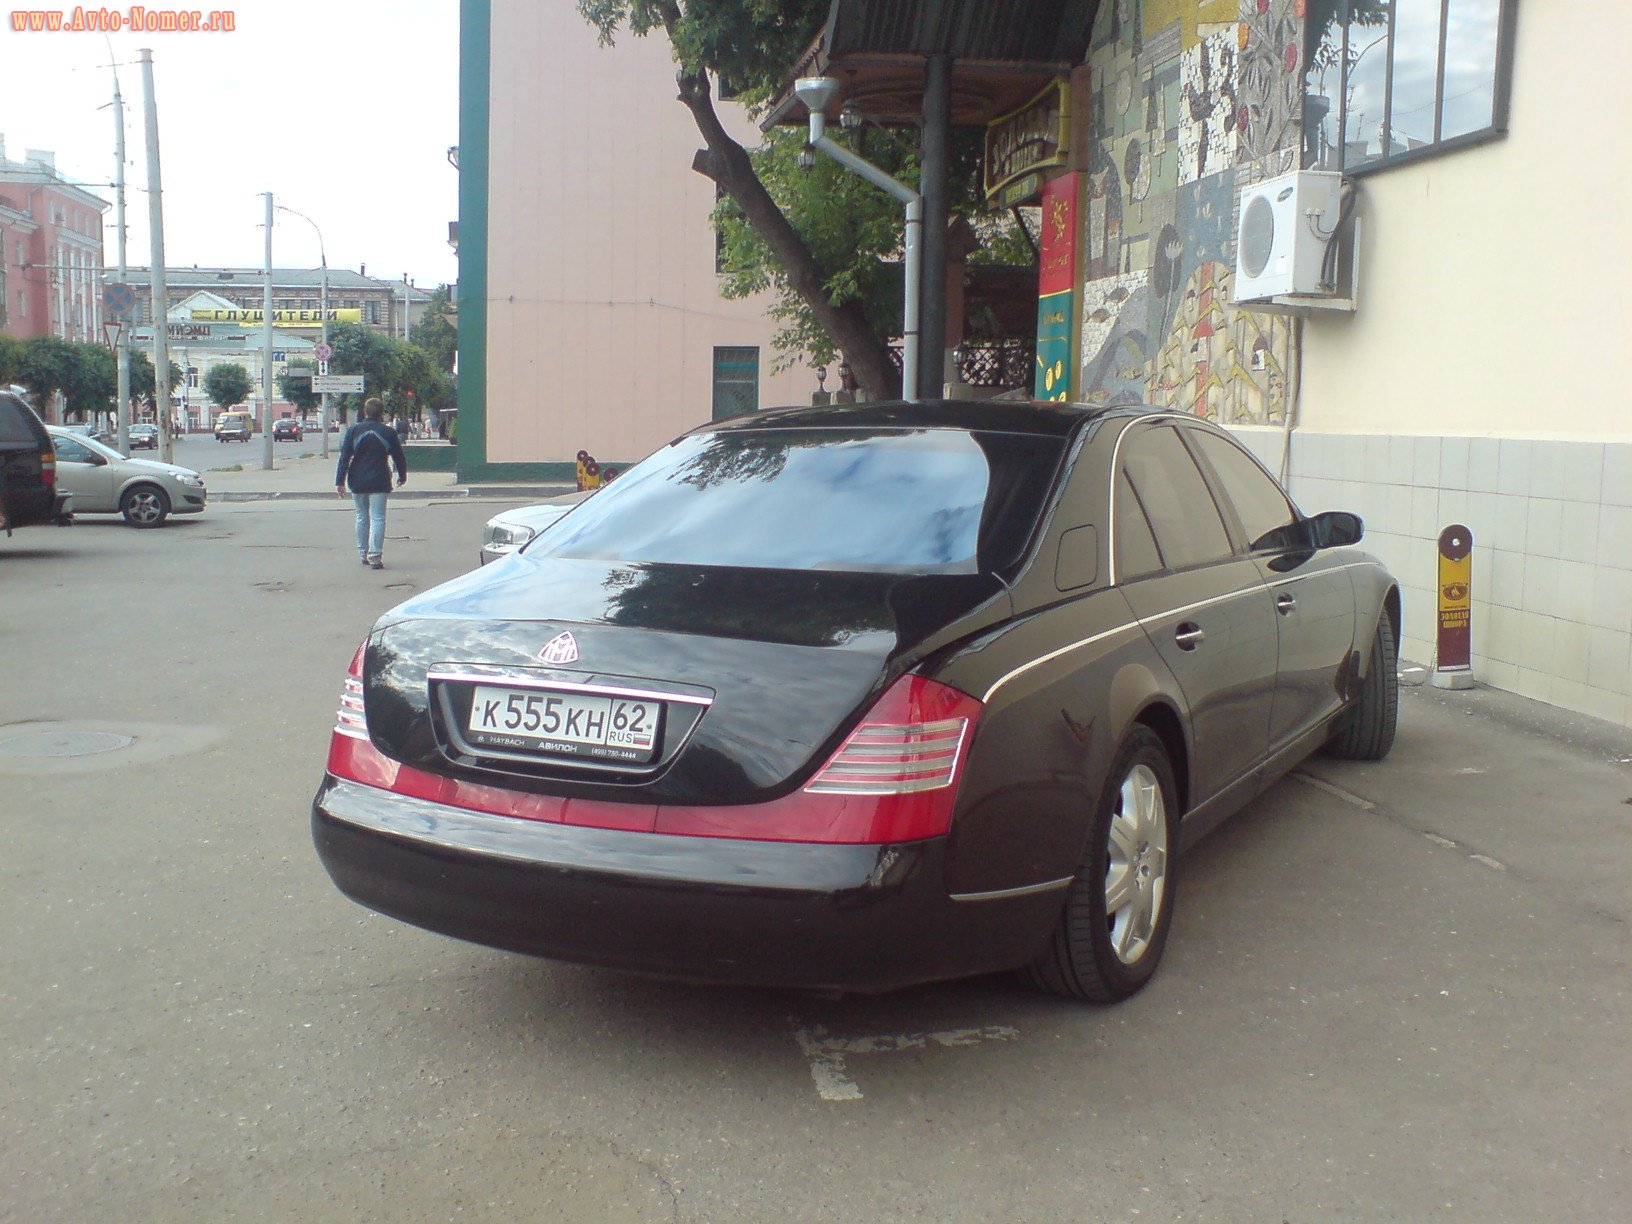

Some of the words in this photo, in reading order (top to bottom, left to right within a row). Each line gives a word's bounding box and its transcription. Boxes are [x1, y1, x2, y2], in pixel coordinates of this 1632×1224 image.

[613, 702, 647, 732] 62
[609, 732, 633, 744] RUS
[538, 741, 578, 753] АВИЛОН
